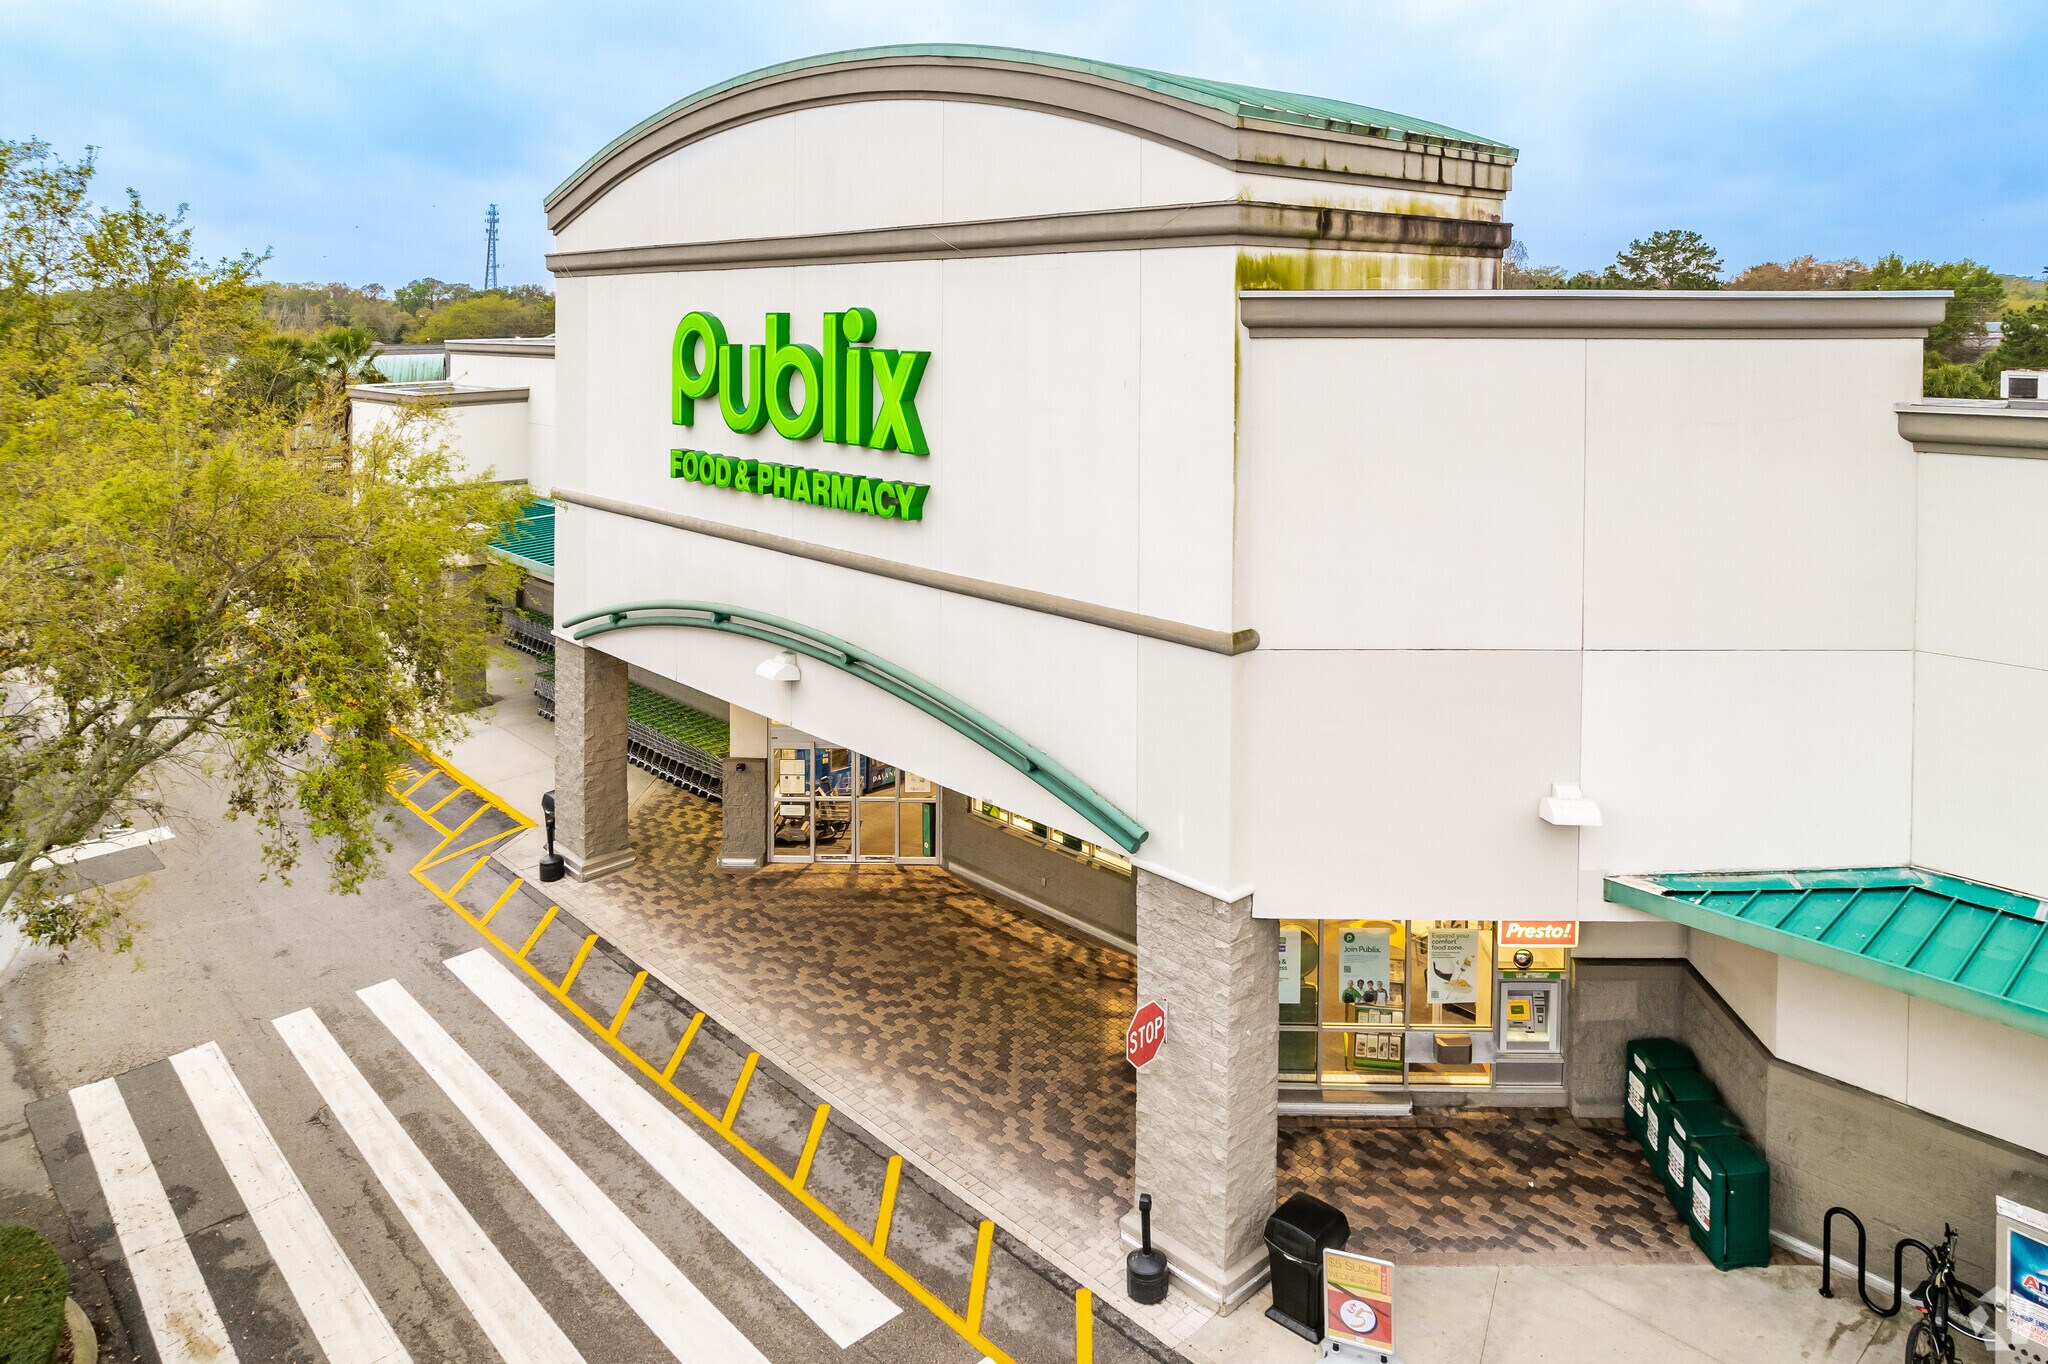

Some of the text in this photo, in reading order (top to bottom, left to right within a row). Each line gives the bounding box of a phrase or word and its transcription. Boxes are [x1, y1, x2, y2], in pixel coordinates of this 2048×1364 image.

[672, 307, 931, 455] Publix
[670, 448, 931, 521] FOOD & PHARMACY
[1505, 922, 1572, 939] Presto!
[1343, 945, 1358, 953] Join
[1129, 1015, 1163, 1054] STOP
[1328, 1257, 1379, 1277] $5 SUSHI
[1328, 1270, 1378, 1286] WEDNESDAY
